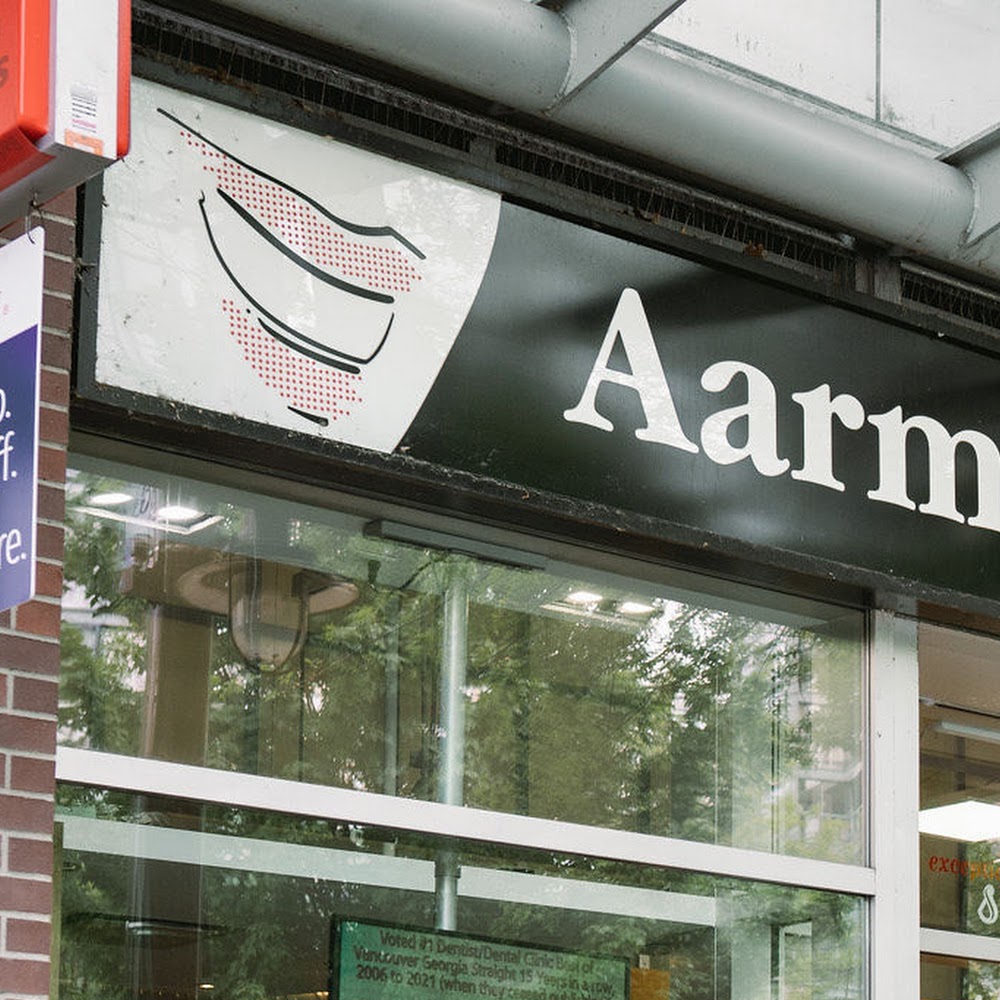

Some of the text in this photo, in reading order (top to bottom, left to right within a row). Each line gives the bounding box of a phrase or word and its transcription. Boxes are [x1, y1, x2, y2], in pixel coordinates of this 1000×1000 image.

[353, 945, 419, 968] Vancouver
[424, 955, 468, 977] Georgia
[472, 962, 515, 983] Straight
[520, 970, 533, 983] 15
[379, 930, 416, 950] Voted
[420, 937, 433, 952] #1
[436, 940, 520, 966] Dentist/Dental
[525, 951, 553, 969] Clinic
[356, 964, 388, 982] 2006
[391, 970, 403, 983] to
[407, 971, 436, 989] 2021
[440, 976, 476, 995] (when
